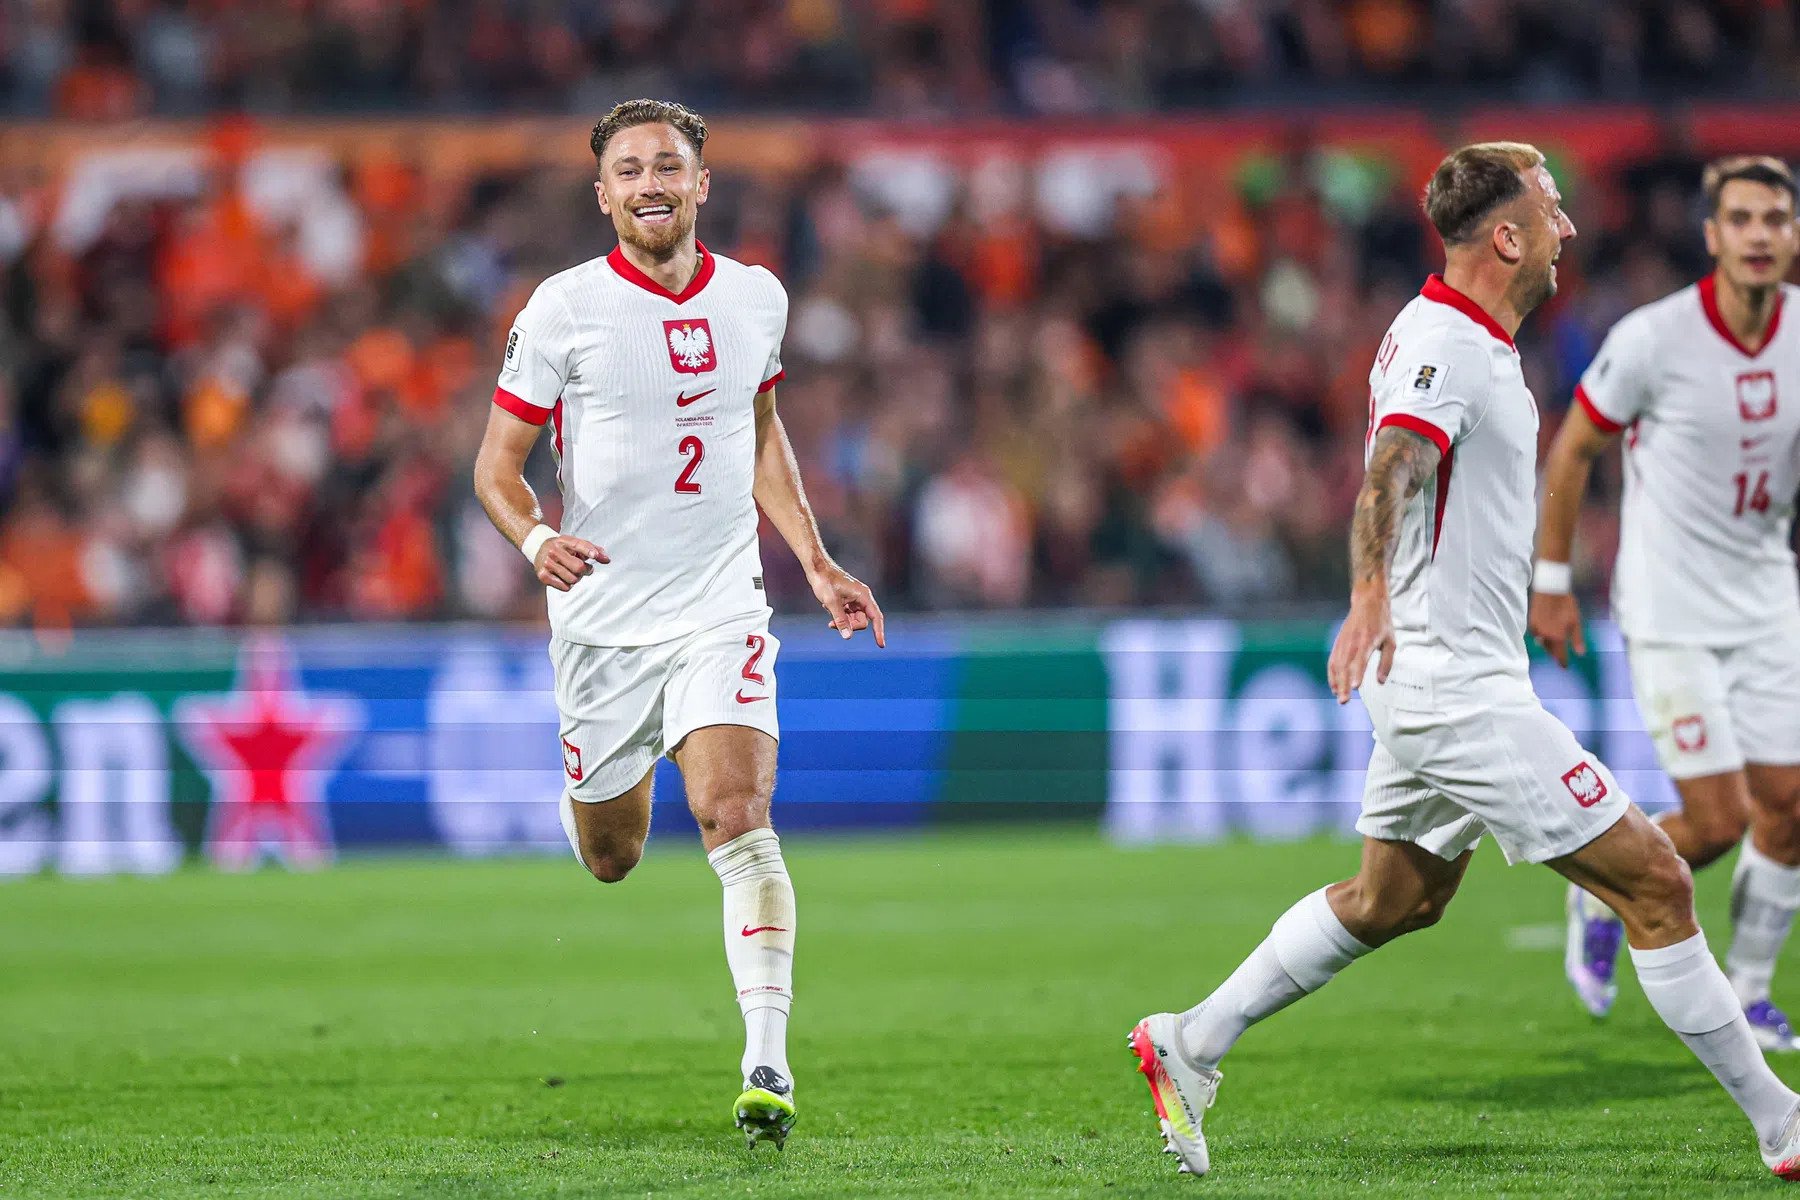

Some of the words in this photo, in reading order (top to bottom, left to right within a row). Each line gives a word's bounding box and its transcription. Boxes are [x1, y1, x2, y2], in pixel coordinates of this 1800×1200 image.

[675, 435, 706, 494] 2
[1733, 470, 1771, 518] 14
[741, 634, 765, 686] 2
